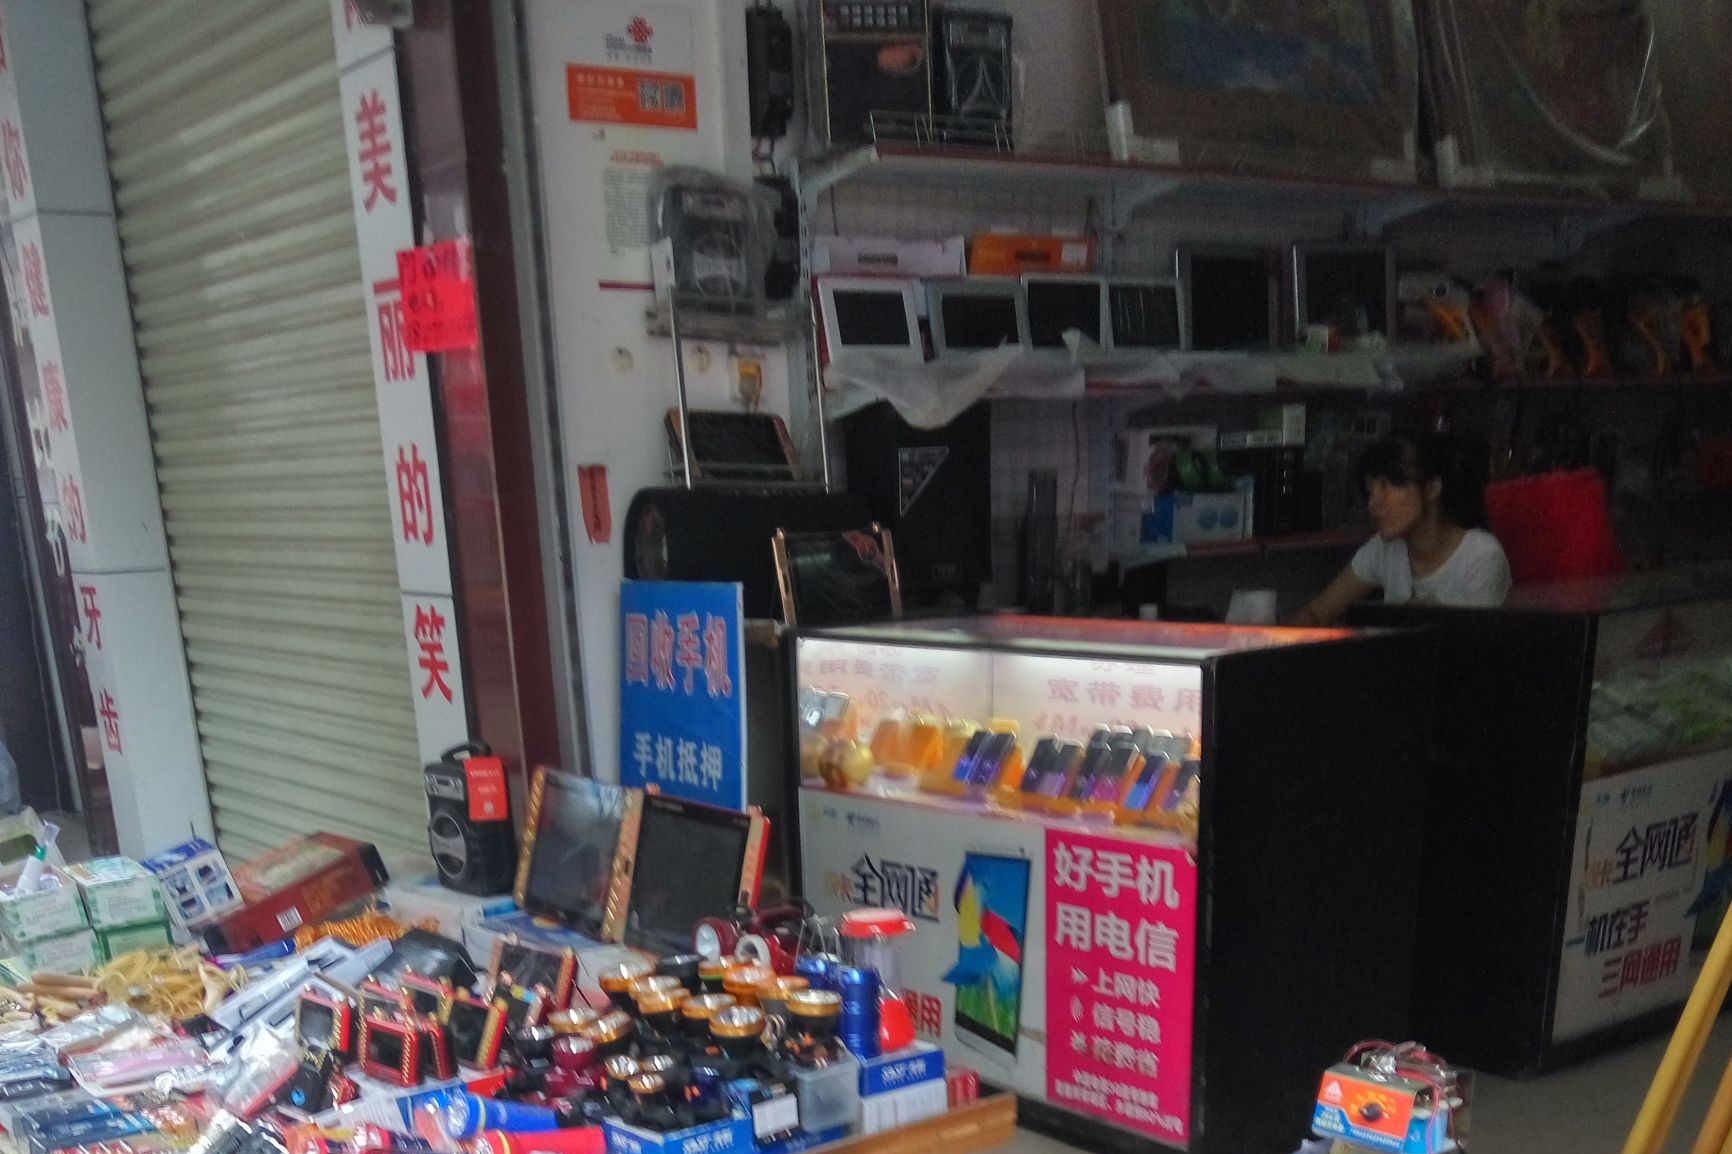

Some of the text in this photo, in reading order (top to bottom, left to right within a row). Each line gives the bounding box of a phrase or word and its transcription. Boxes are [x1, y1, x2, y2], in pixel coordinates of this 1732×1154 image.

[344, 0, 453, 704] 美丽的笑
[624, 609, 733, 699] 回收手机
[1053, 840, 1180, 910] 好手机
[1054, 901, 1180, 973] 用电信
[1598, 933, 1682, 999] 三网通用
[1091, 967, 1161, 1009] 上网快
[1092, 1001, 1162, 1045] 信号稳
